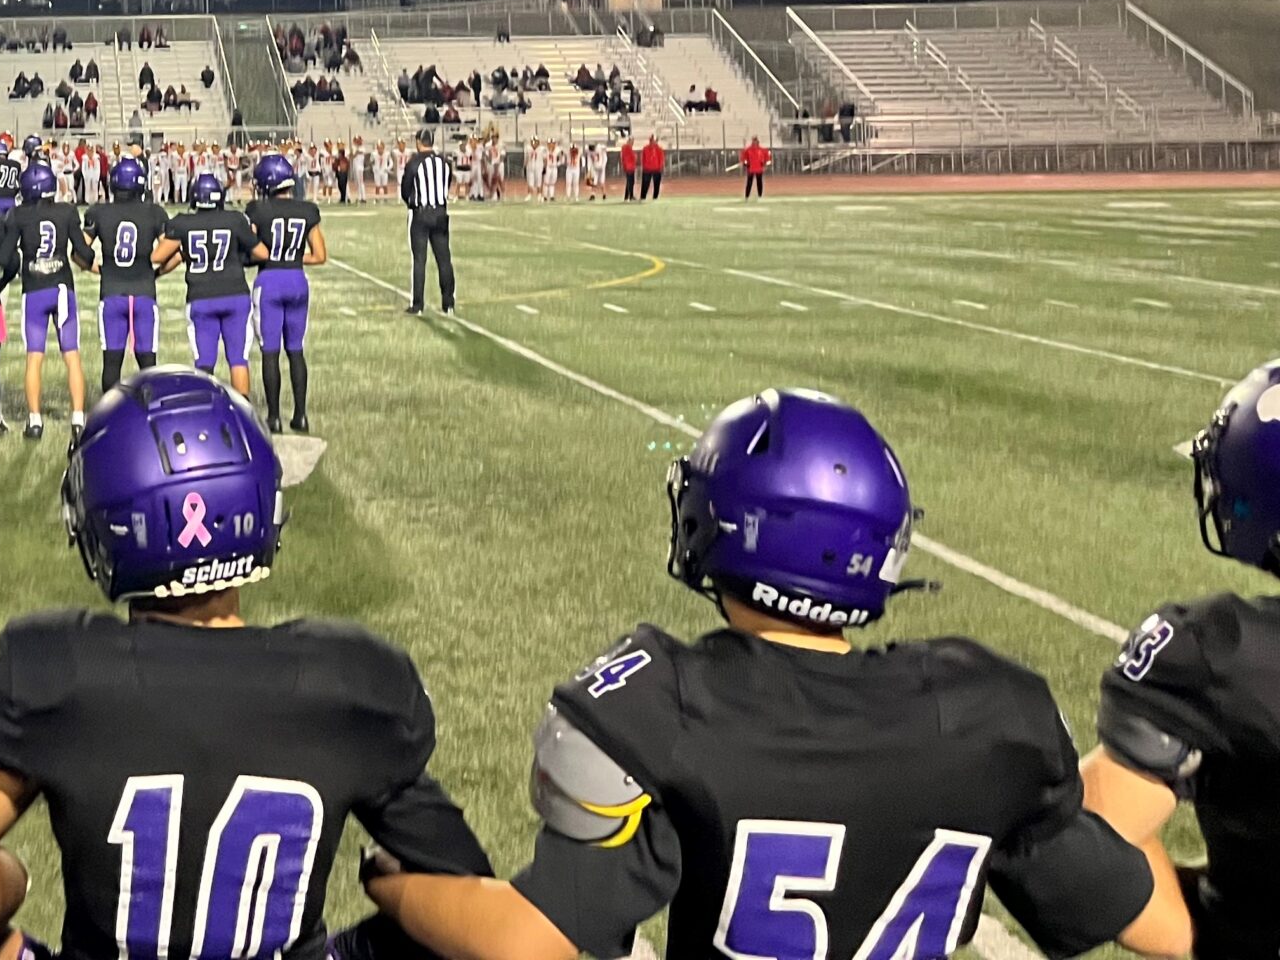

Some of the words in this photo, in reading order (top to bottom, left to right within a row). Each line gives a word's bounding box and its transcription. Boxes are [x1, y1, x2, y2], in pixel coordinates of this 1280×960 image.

[37, 221, 57, 259] 3
[114, 221, 138, 267] 8
[187, 229, 231, 273] 57
[270, 218, 306, 261] 17
[233, 512, 254, 538] 10
[846, 552, 874, 579] 54
[752, 581, 869, 626] Riddell
[107, 774, 324, 960] 10
[712, 818, 993, 960] 54
